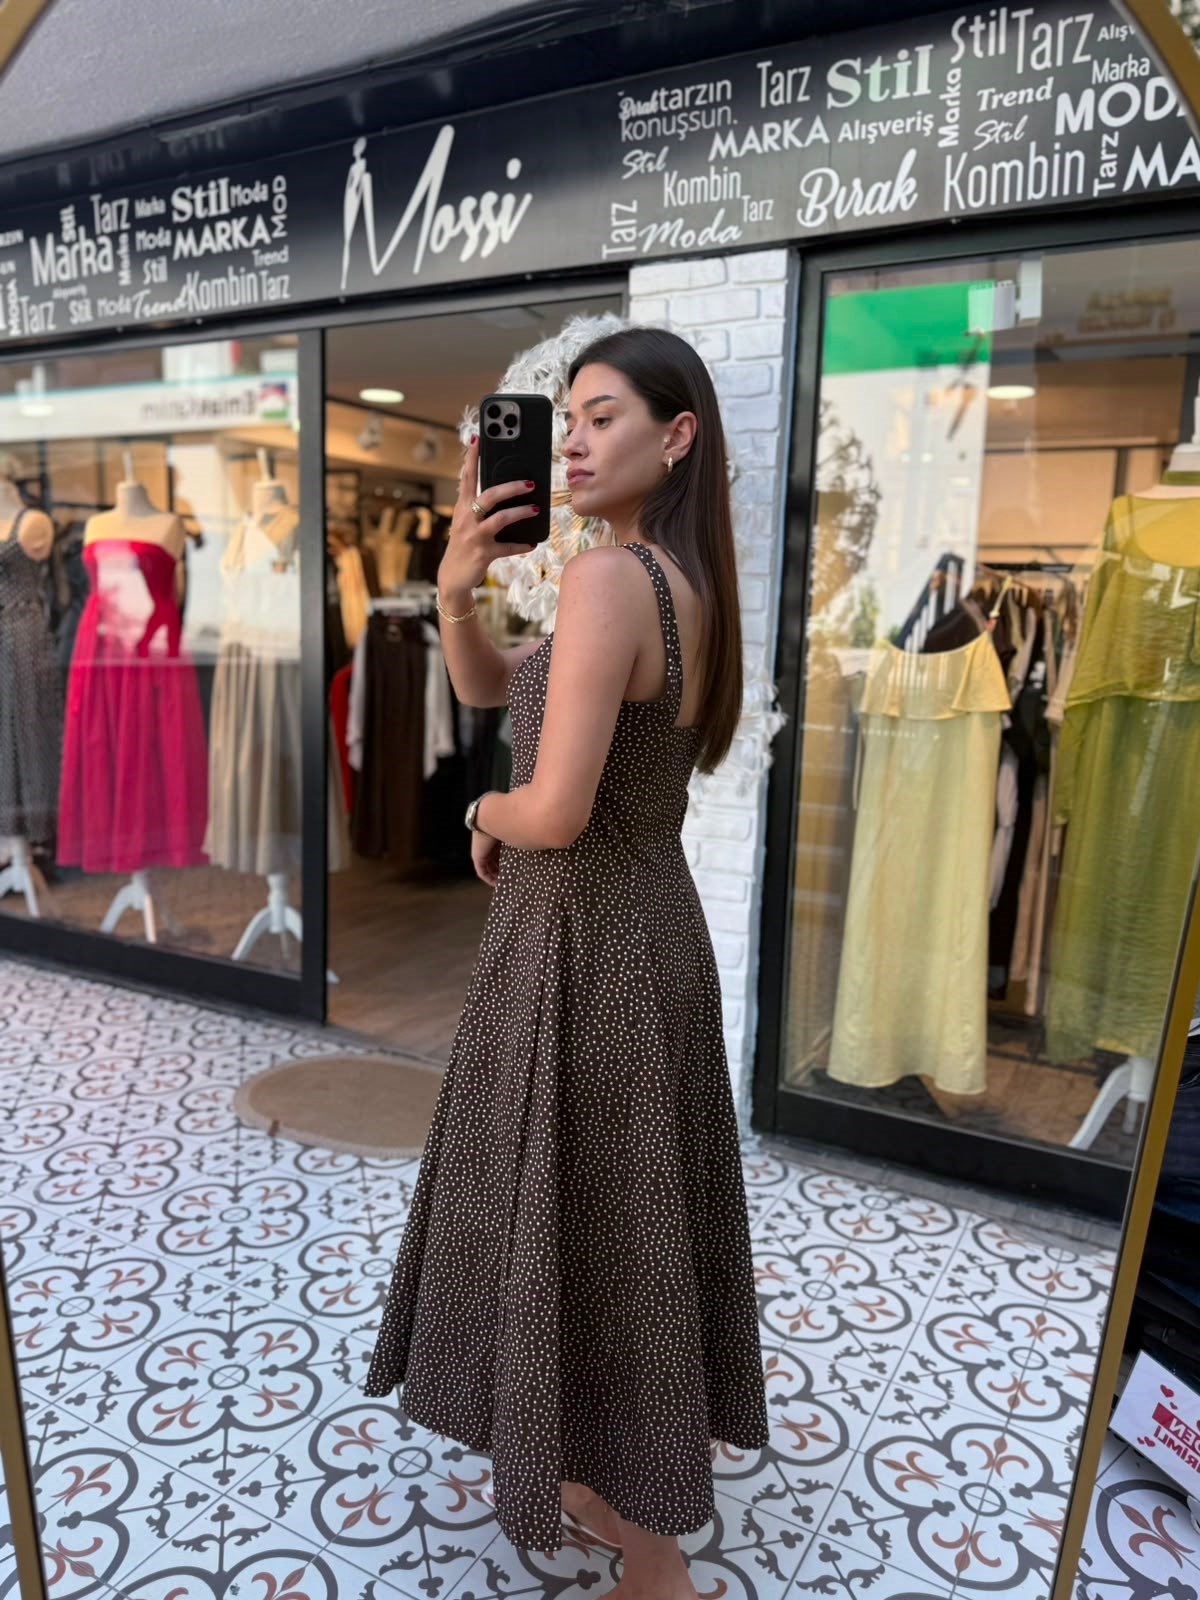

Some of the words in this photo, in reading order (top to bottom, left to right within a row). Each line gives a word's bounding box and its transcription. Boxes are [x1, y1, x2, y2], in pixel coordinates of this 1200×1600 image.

[951, 6, 1008, 64] Stil
[1010, 7, 1095, 74] Tarz
[756, 60, 811, 108] Tarz
[826, 44, 934, 109] Stil
[1091, 53, 1150, 85] Marka
[658, 79, 732, 111] tarzın
[937, 67, 962, 148] Marka
[976, 76, 1055, 112] Trend
[1054, 76, 1187, 136] MOD
[621, 105, 738, 143] konuşsun.
[708, 115, 830, 162] MARKA
[837, 110, 934, 145] Alışveriş
[972, 114, 1029, 151] Stil
[621, 146, 669, 180] Stil
[943, 140, 1087, 212] Kombin
[1092, 130, 1119, 198] Tarz
[171, 177, 230, 224] Stil
[230, 180, 269, 208] Moda
[341, 124, 533, 291] Mossi
[663, 165, 741, 208] Kombin
[741, 195, 774, 222] Tarz
[796, 147, 919, 228] Bırak
[90, 194, 131, 235] Tarz
[601, 199, 638, 260] Tarz
[639, 208, 743, 253] Moda
[29, 225, 114, 287] Marka
[135, 226, 172, 251] Moda
[173, 214, 272, 261] MARKA
[252, 245, 289, 267] Trend
[143, 255, 168, 285] Stil
[186, 265, 259, 313] Kombin
[259, 269, 291, 301] Tarz
[20, 295, 56, 335] Tarz
